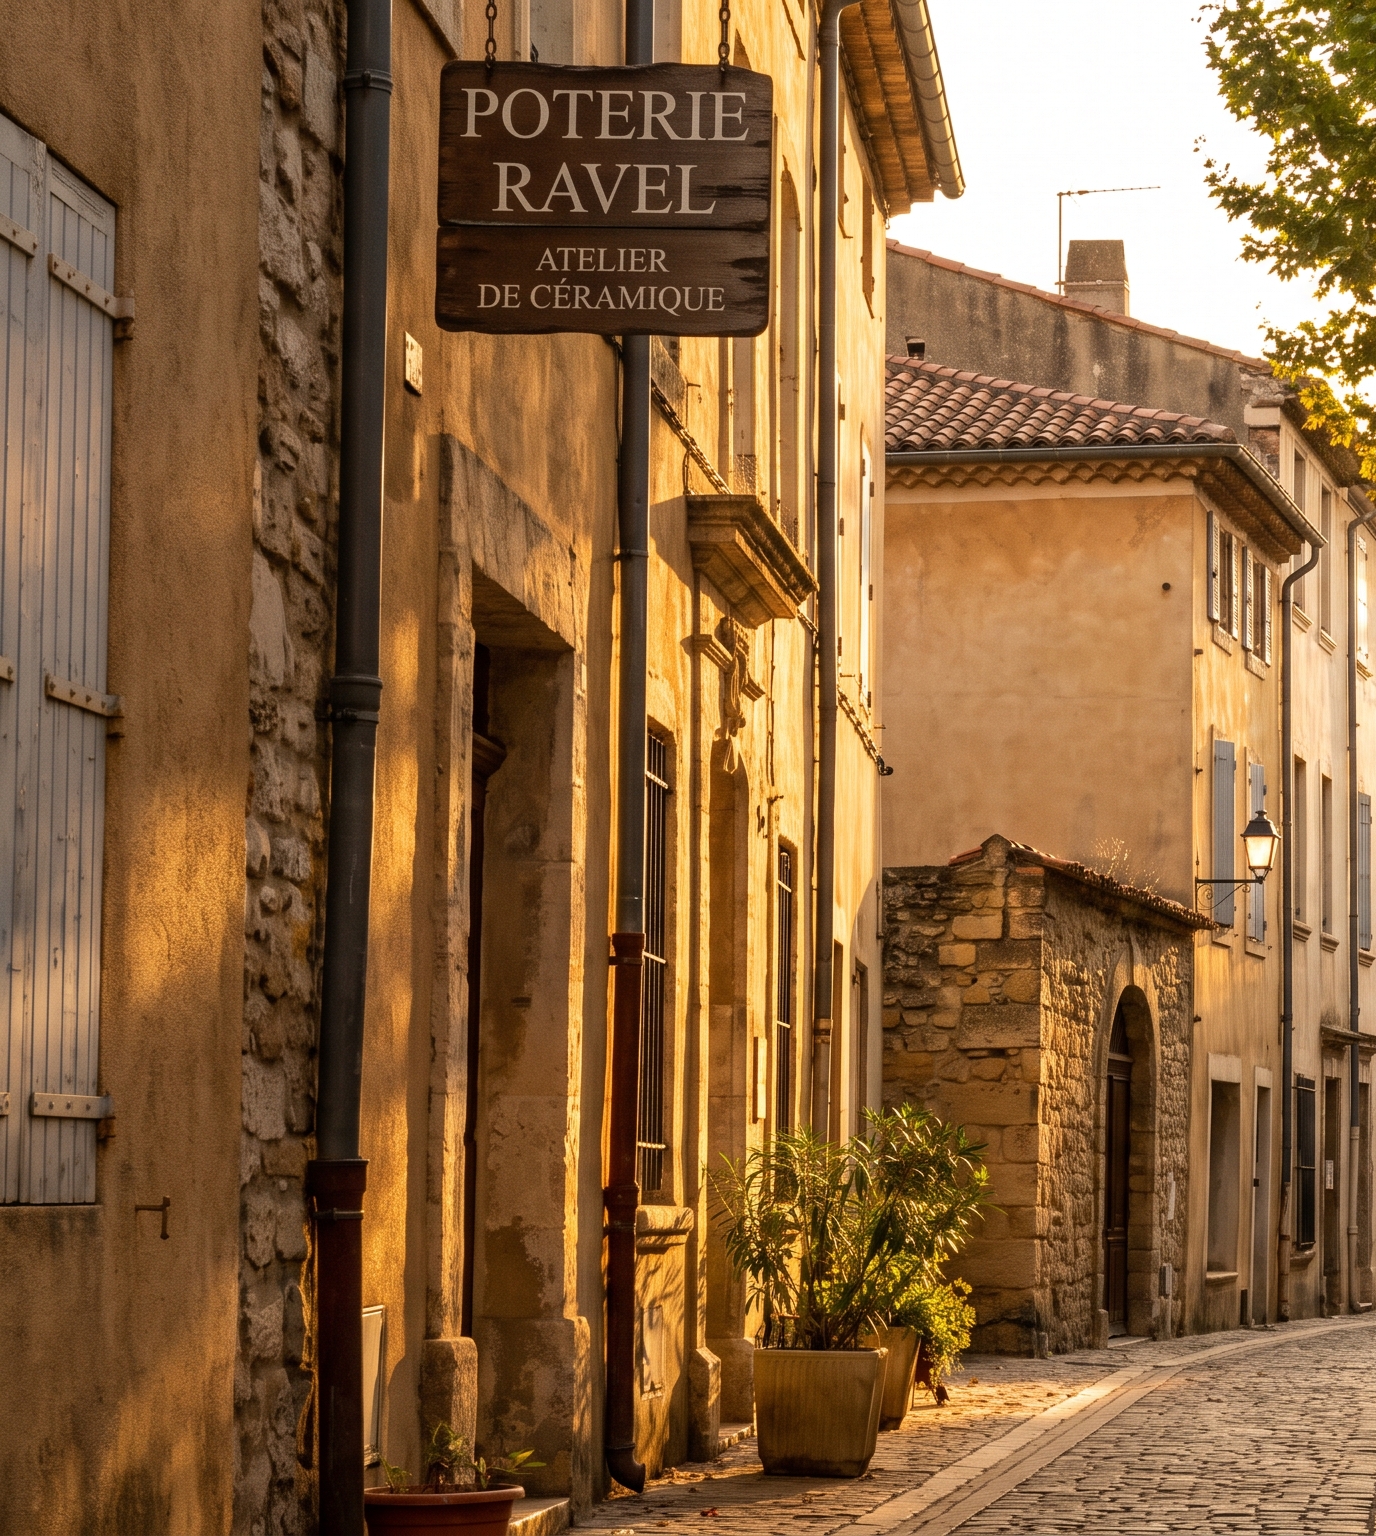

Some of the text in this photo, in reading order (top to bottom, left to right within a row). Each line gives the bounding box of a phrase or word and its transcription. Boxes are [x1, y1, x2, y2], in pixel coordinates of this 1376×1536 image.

[459, 88, 750, 142] POTERIE
[491, 161, 717, 215] RAVEL
[535, 247, 671, 273] ATELIER
[476, 277, 726, 317] DE CÉRAMIQUE
